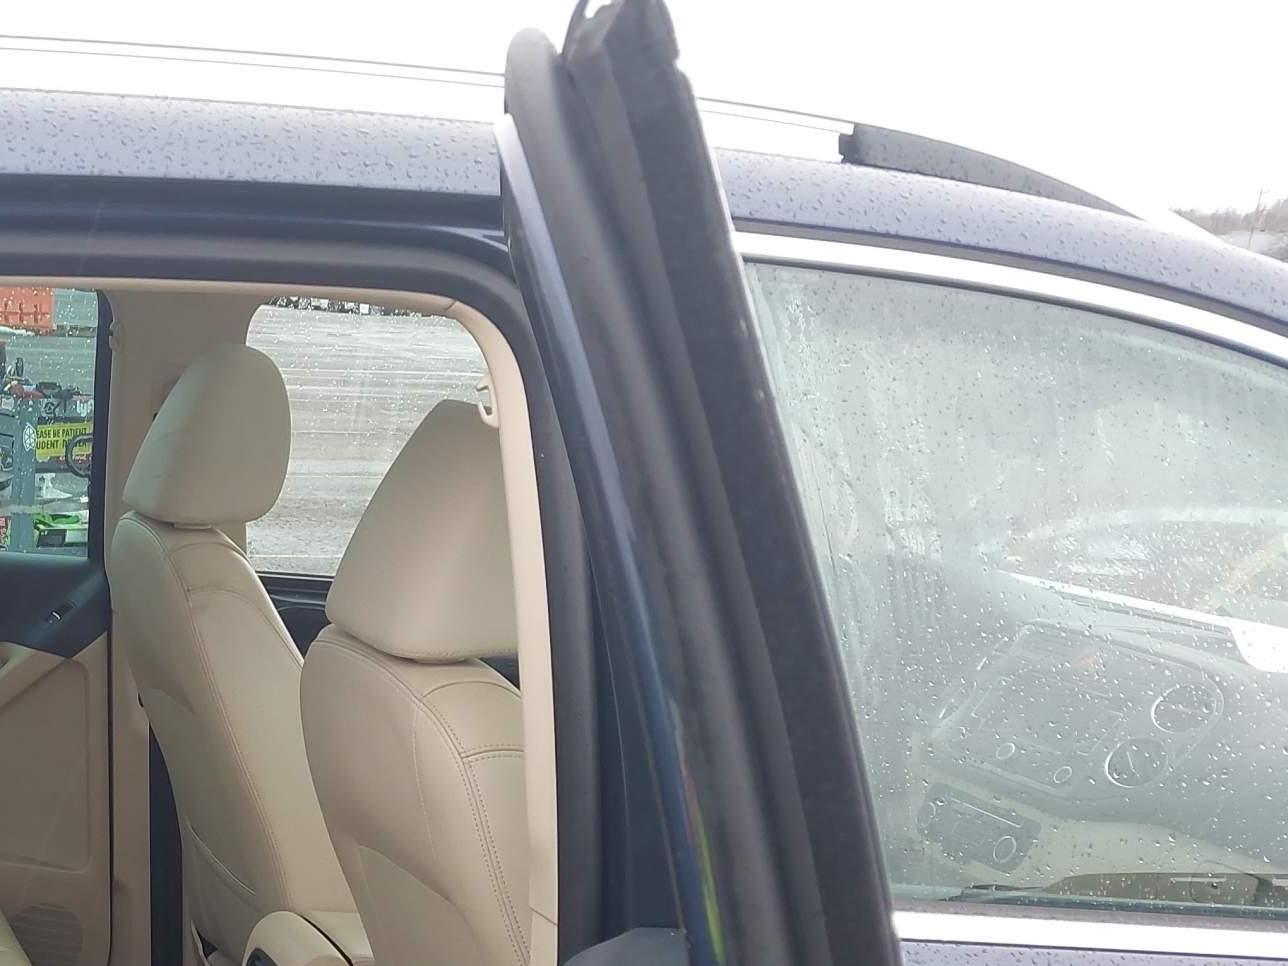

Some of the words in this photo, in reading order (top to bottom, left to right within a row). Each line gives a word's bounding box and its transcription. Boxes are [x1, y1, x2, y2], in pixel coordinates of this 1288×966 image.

[36, 429, 52, 439] EASE
[52, 428, 61, 438] BE
[36, 439, 59, 449] UDENT
